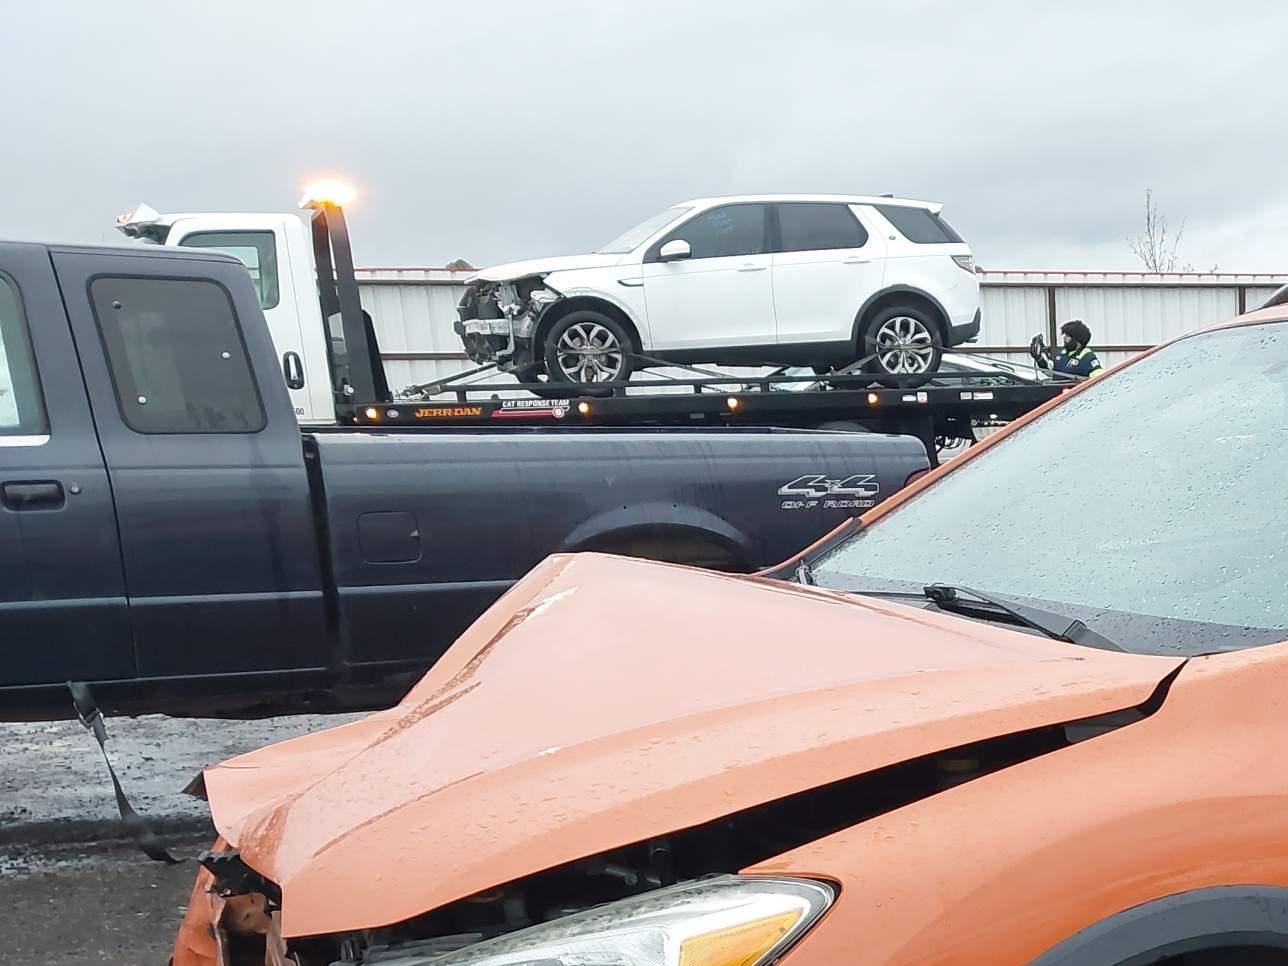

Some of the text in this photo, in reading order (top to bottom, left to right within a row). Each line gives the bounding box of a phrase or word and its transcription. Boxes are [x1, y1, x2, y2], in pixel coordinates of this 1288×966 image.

[502, 400, 516, 408] CAT
[781, 500, 875, 509] OFF ROAD
